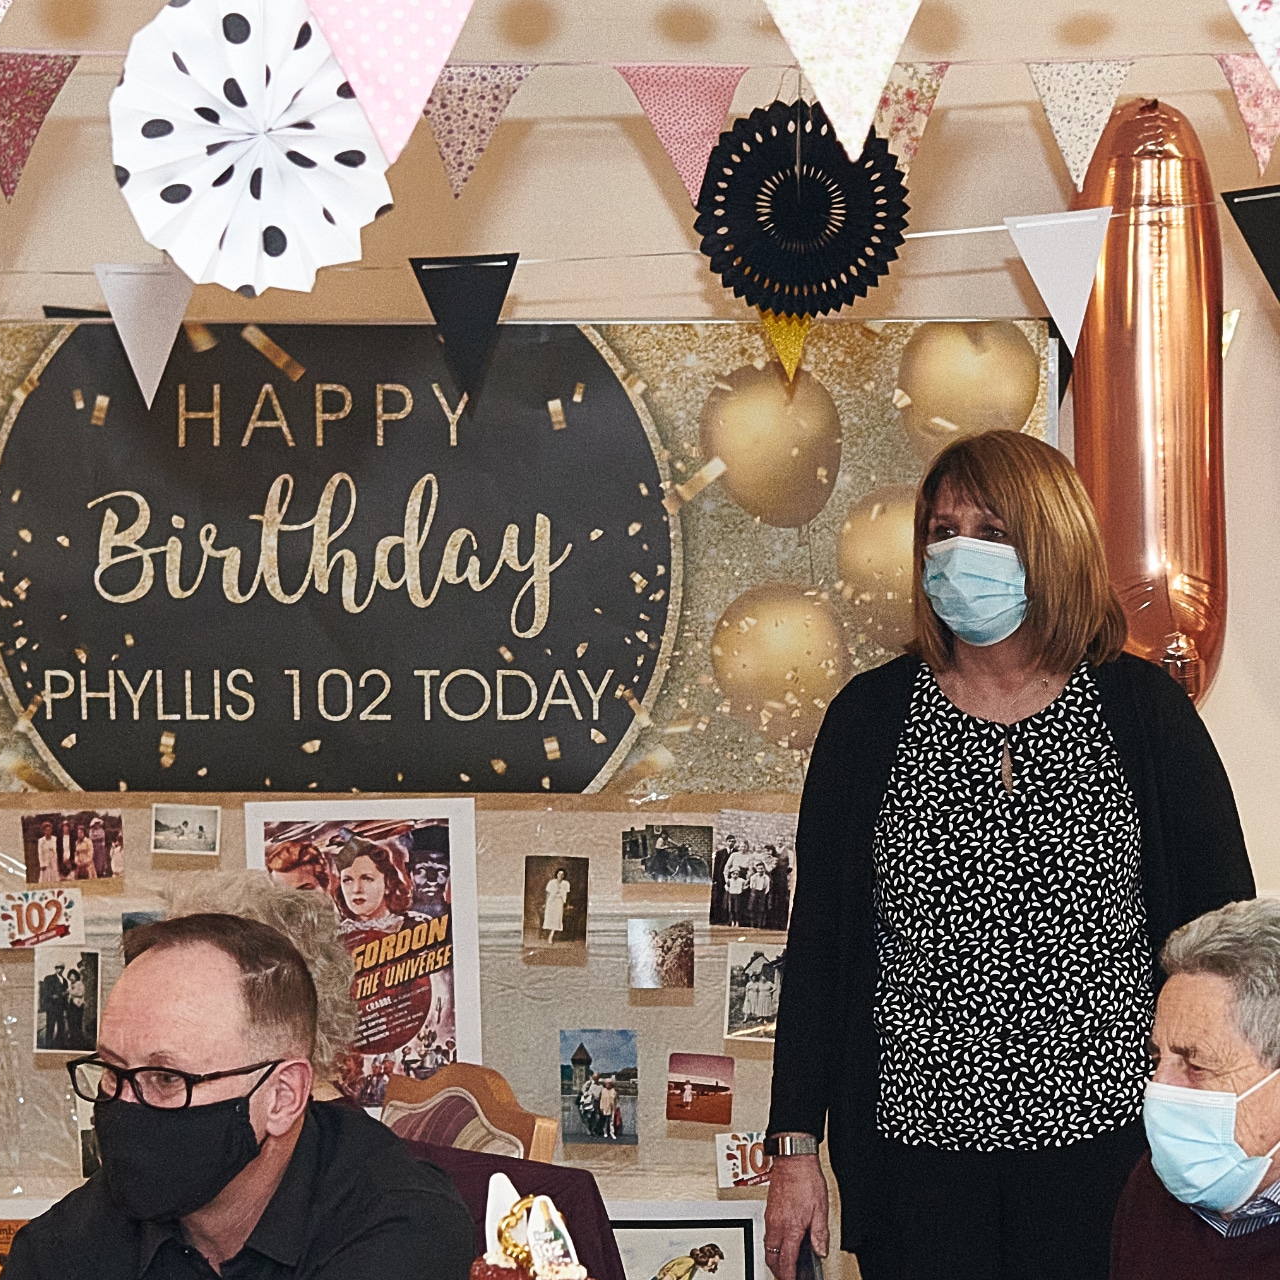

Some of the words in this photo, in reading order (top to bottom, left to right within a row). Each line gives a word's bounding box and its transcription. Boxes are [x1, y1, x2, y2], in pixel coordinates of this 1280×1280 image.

[177, 382, 470, 448] HAPPY
[87, 472, 573, 640] Birthday
[43, 668, 256, 721] PHYLLIS
[283, 668, 392, 721] 102
[413, 668, 616, 721] TODAY
[11, 899, 63, 936] 102
[351, 913, 450, 972] GORDON
[356, 971, 382, 1000] THE
[384, 944, 453, 988] UNIVERSE
[735, 1142, 771, 1175] 10
